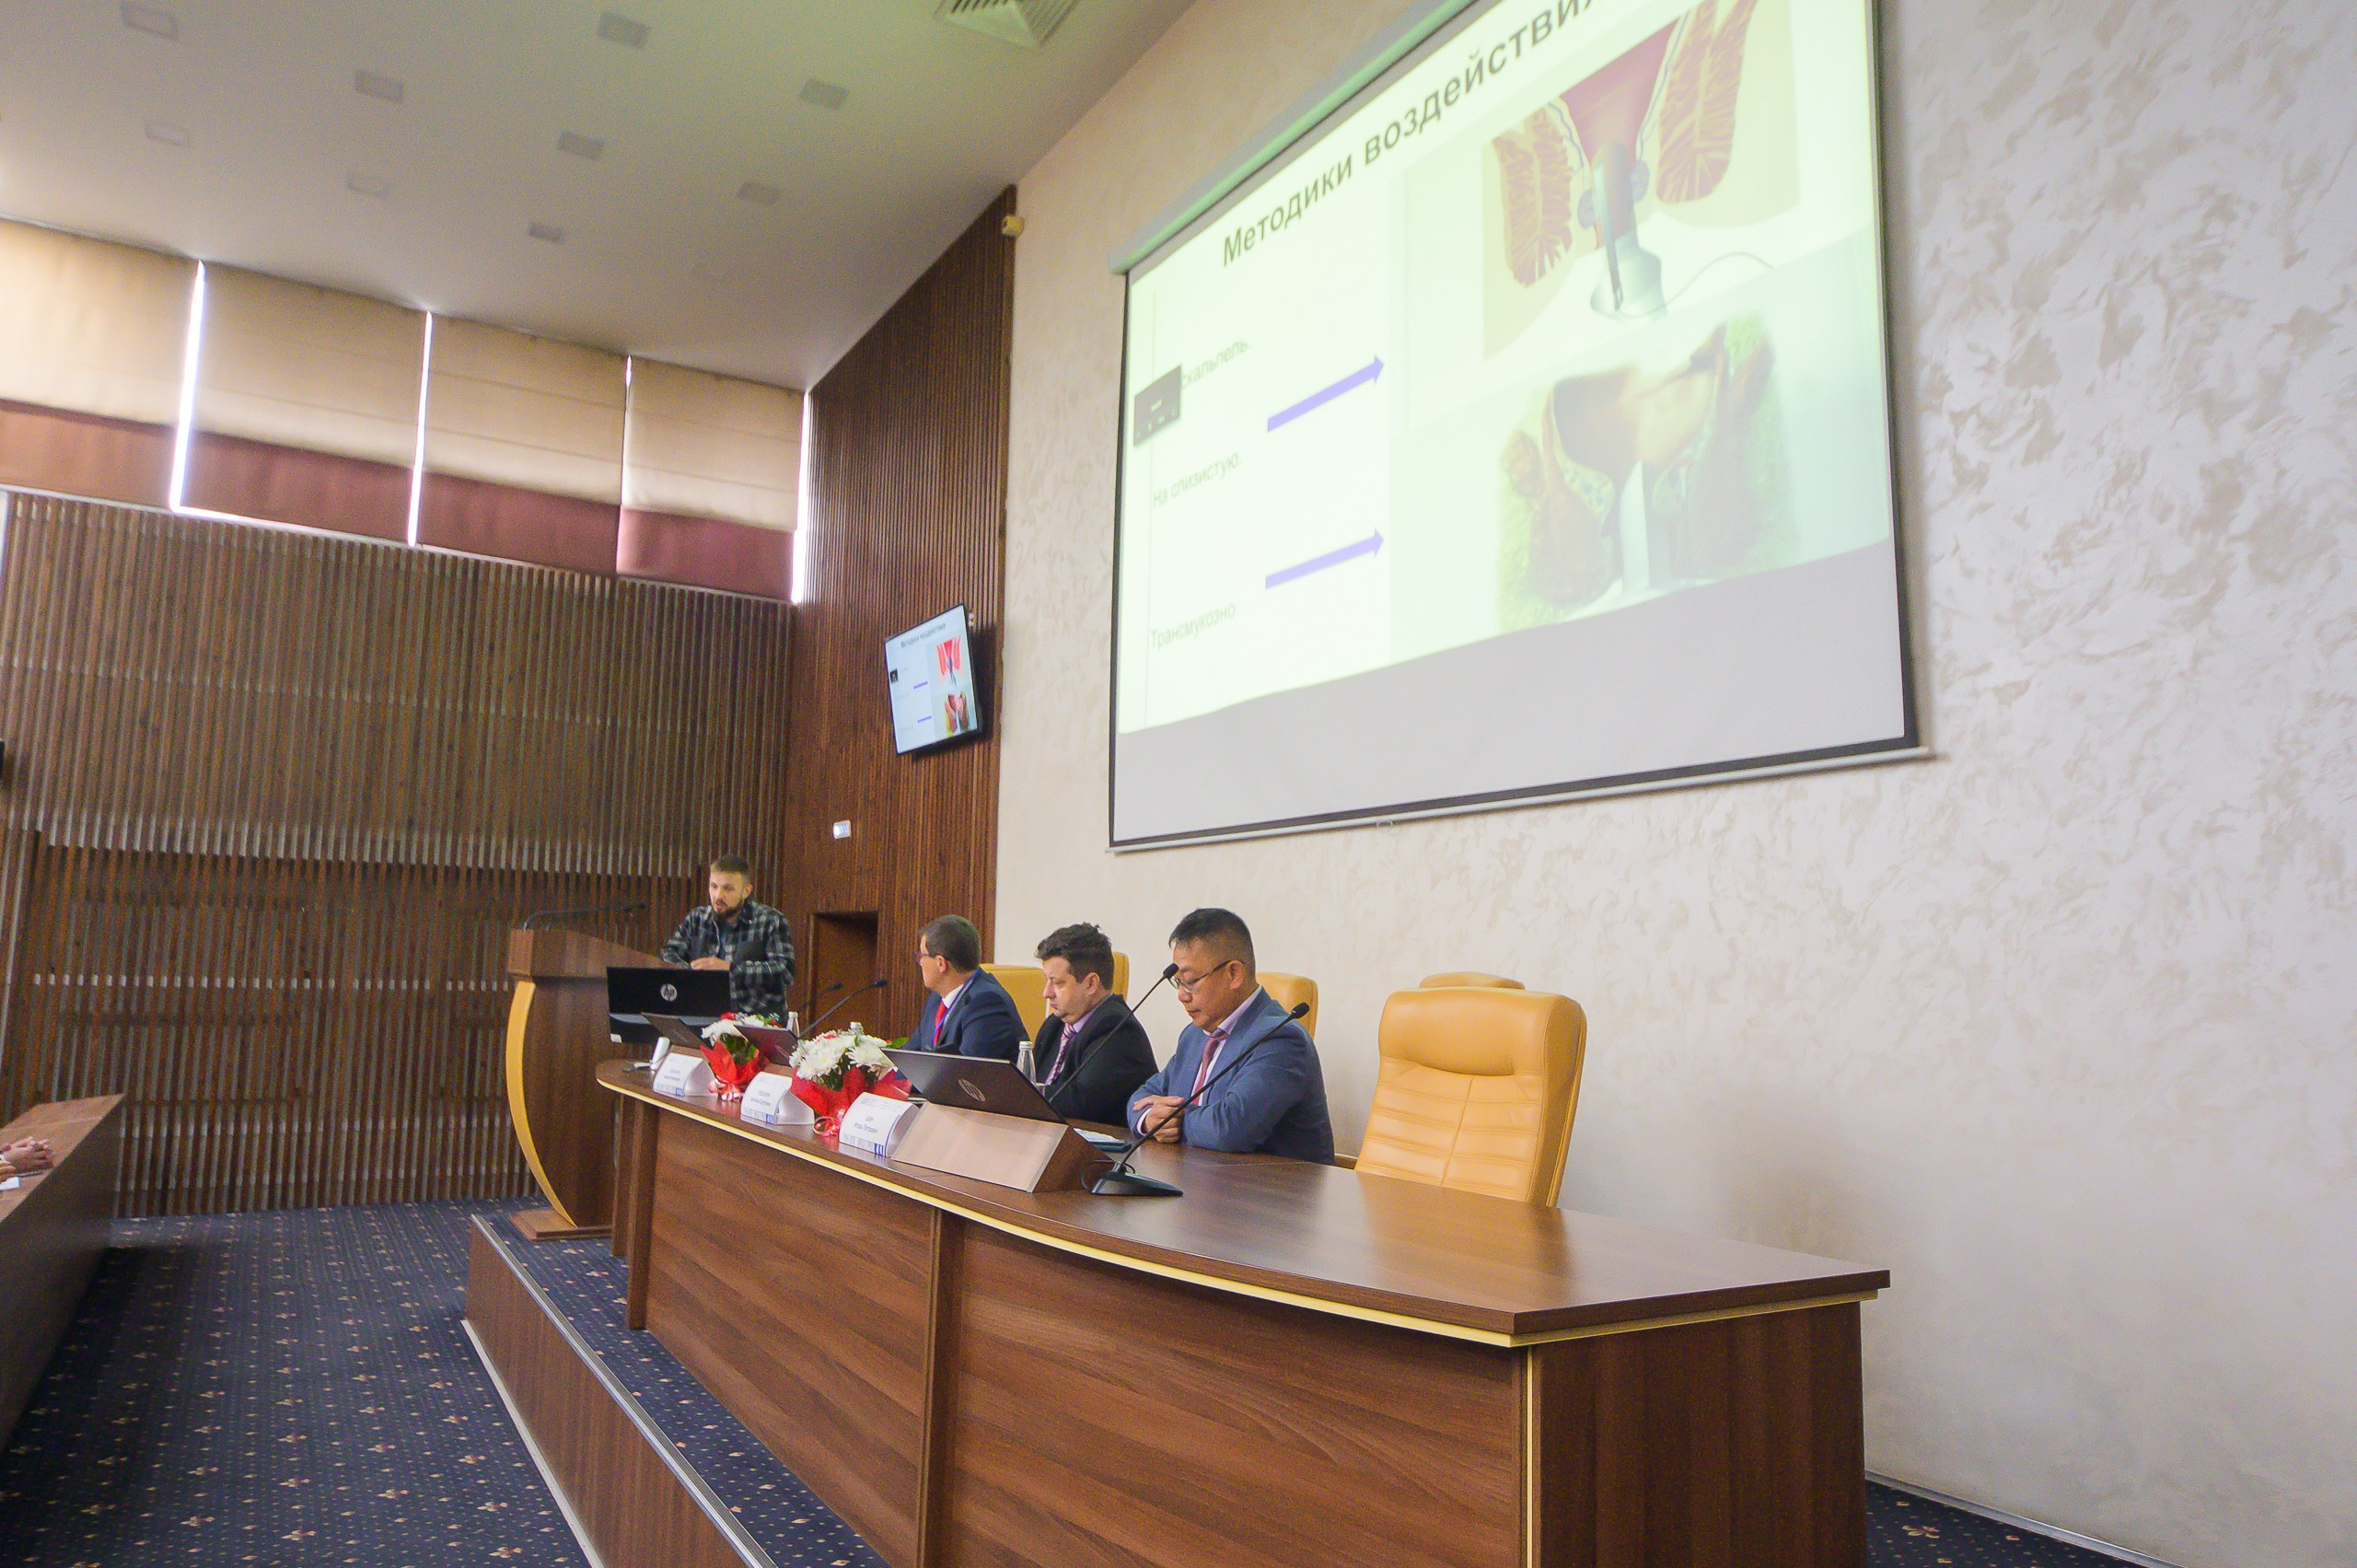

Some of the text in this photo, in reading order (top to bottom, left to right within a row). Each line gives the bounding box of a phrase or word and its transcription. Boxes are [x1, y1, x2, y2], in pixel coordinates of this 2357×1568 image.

[1224, 0, 1592, 267] Методики воздействи
[1153, 488, 1168, 509] На
